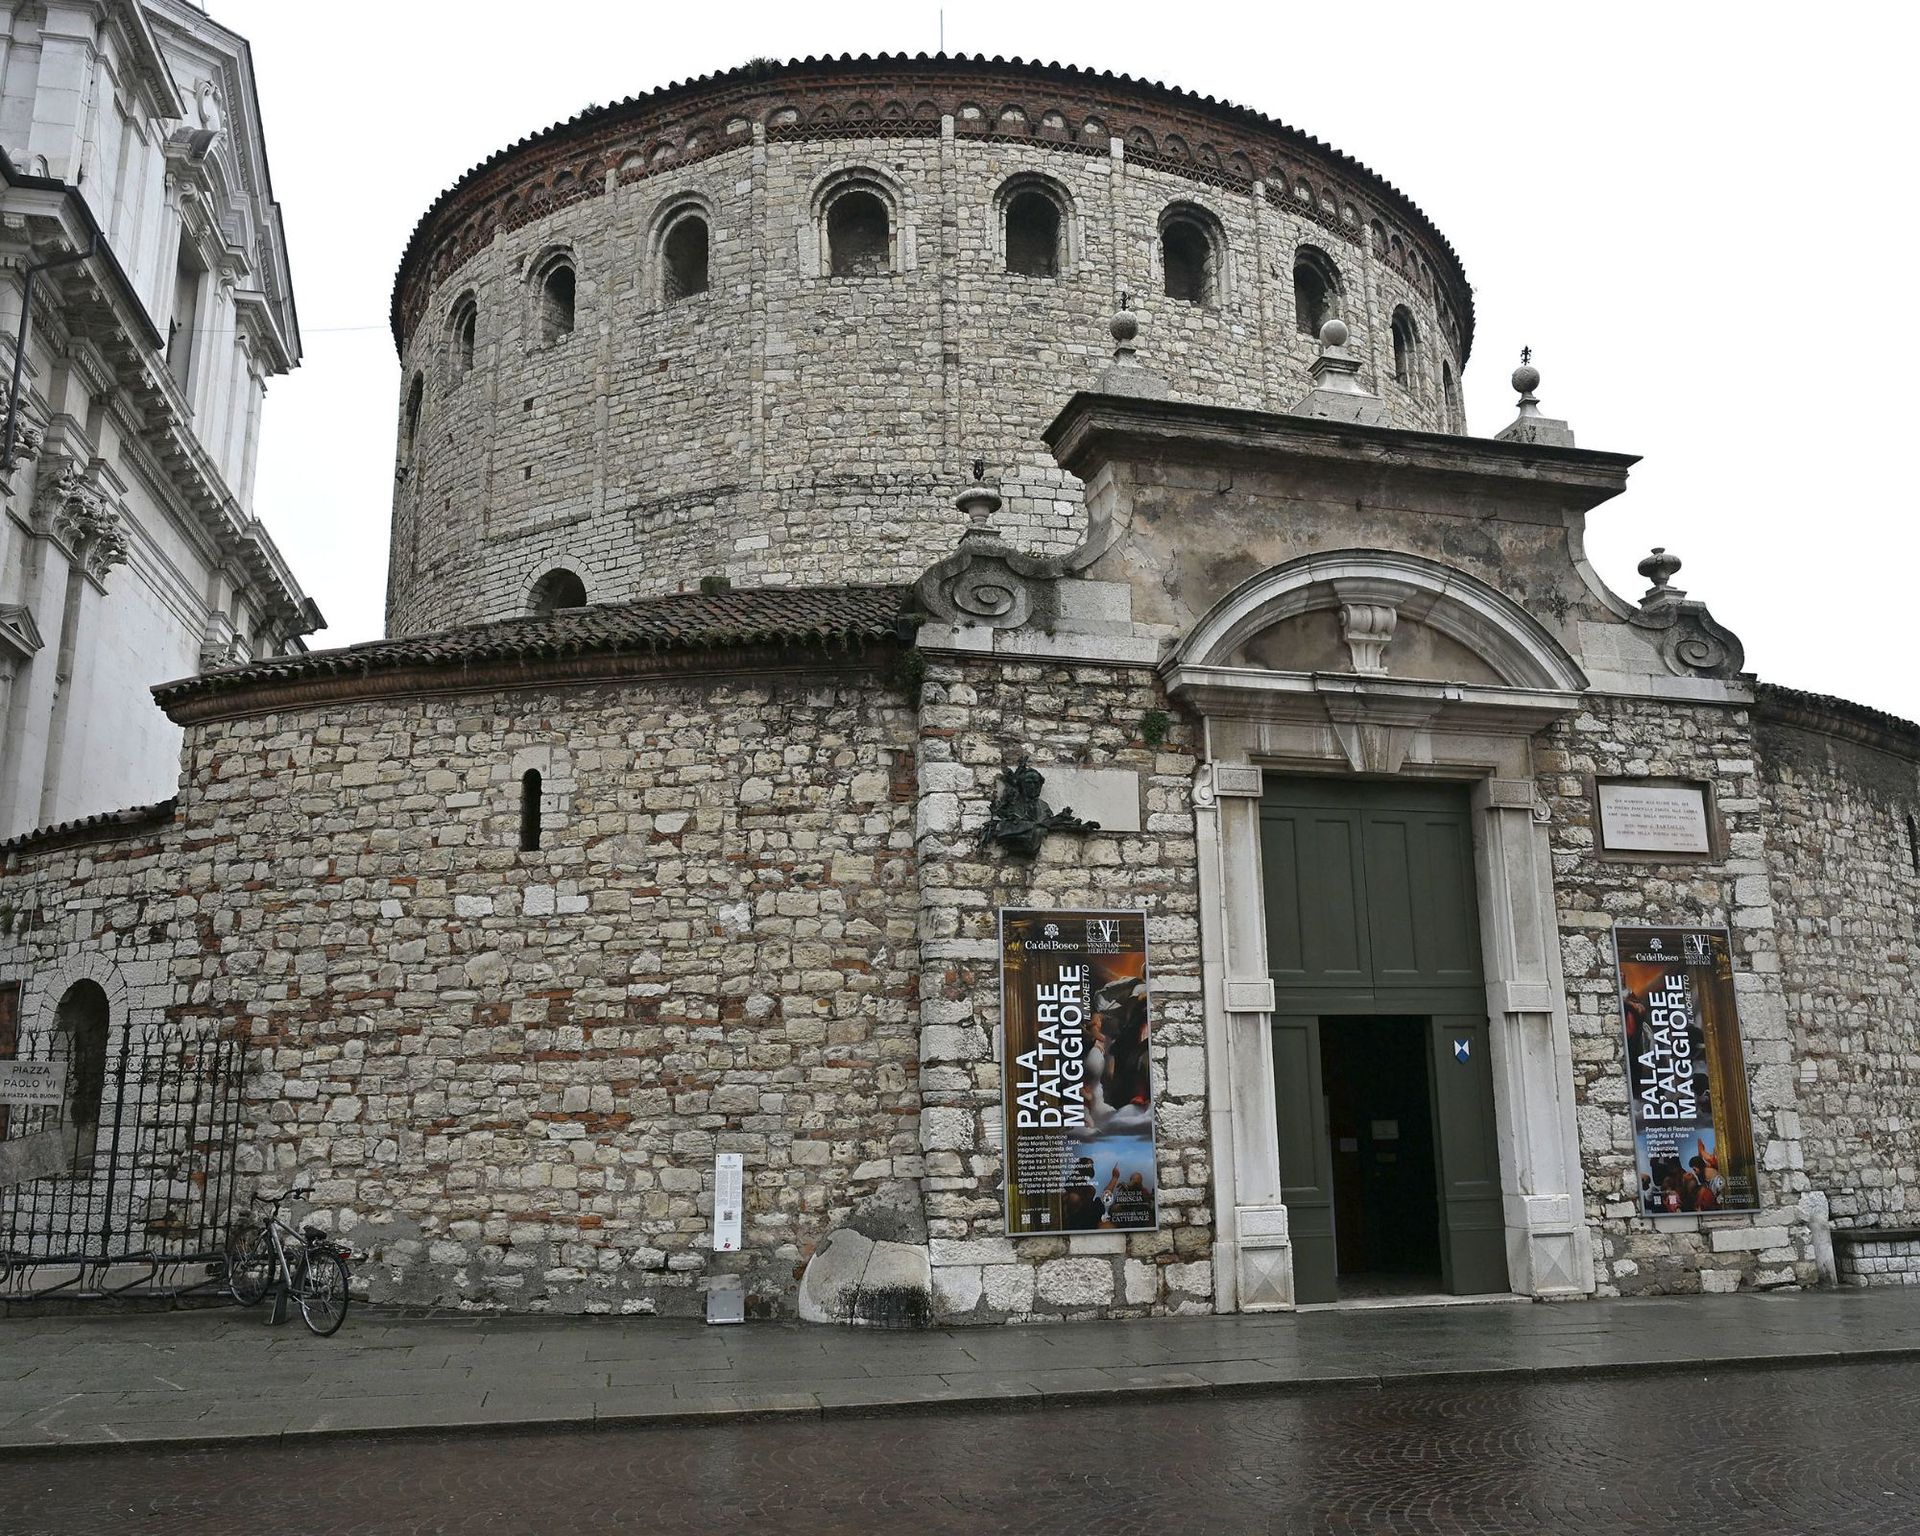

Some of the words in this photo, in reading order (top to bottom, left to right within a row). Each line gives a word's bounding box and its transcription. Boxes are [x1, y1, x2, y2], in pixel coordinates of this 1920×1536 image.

[1052, 941, 1078, 950] Bosco
[1658, 953, 1678, 962] Bosco
[1082, 964, 1090, 1012] MORETTO
[1682, 974, 1694, 1016] MORETTO
[1084, 1012, 1091, 1020] IL
[12, 1066, 50, 1074] PIAZZA
[1036, 984, 1062, 1128] D'ALTARE
[1059, 965, 1086, 1127] MAGGIORE
[1648, 992, 1678, 1120] D'ALTARE
[1665, 975, 1697, 1119] MAGGIORE
[4, 1079, 40, 1088] PAOLO
[46, 1080, 56, 1088] VI
[1016, 1050, 1039, 1128] PALA
[1638, 1050, 1662, 1120] PALA
